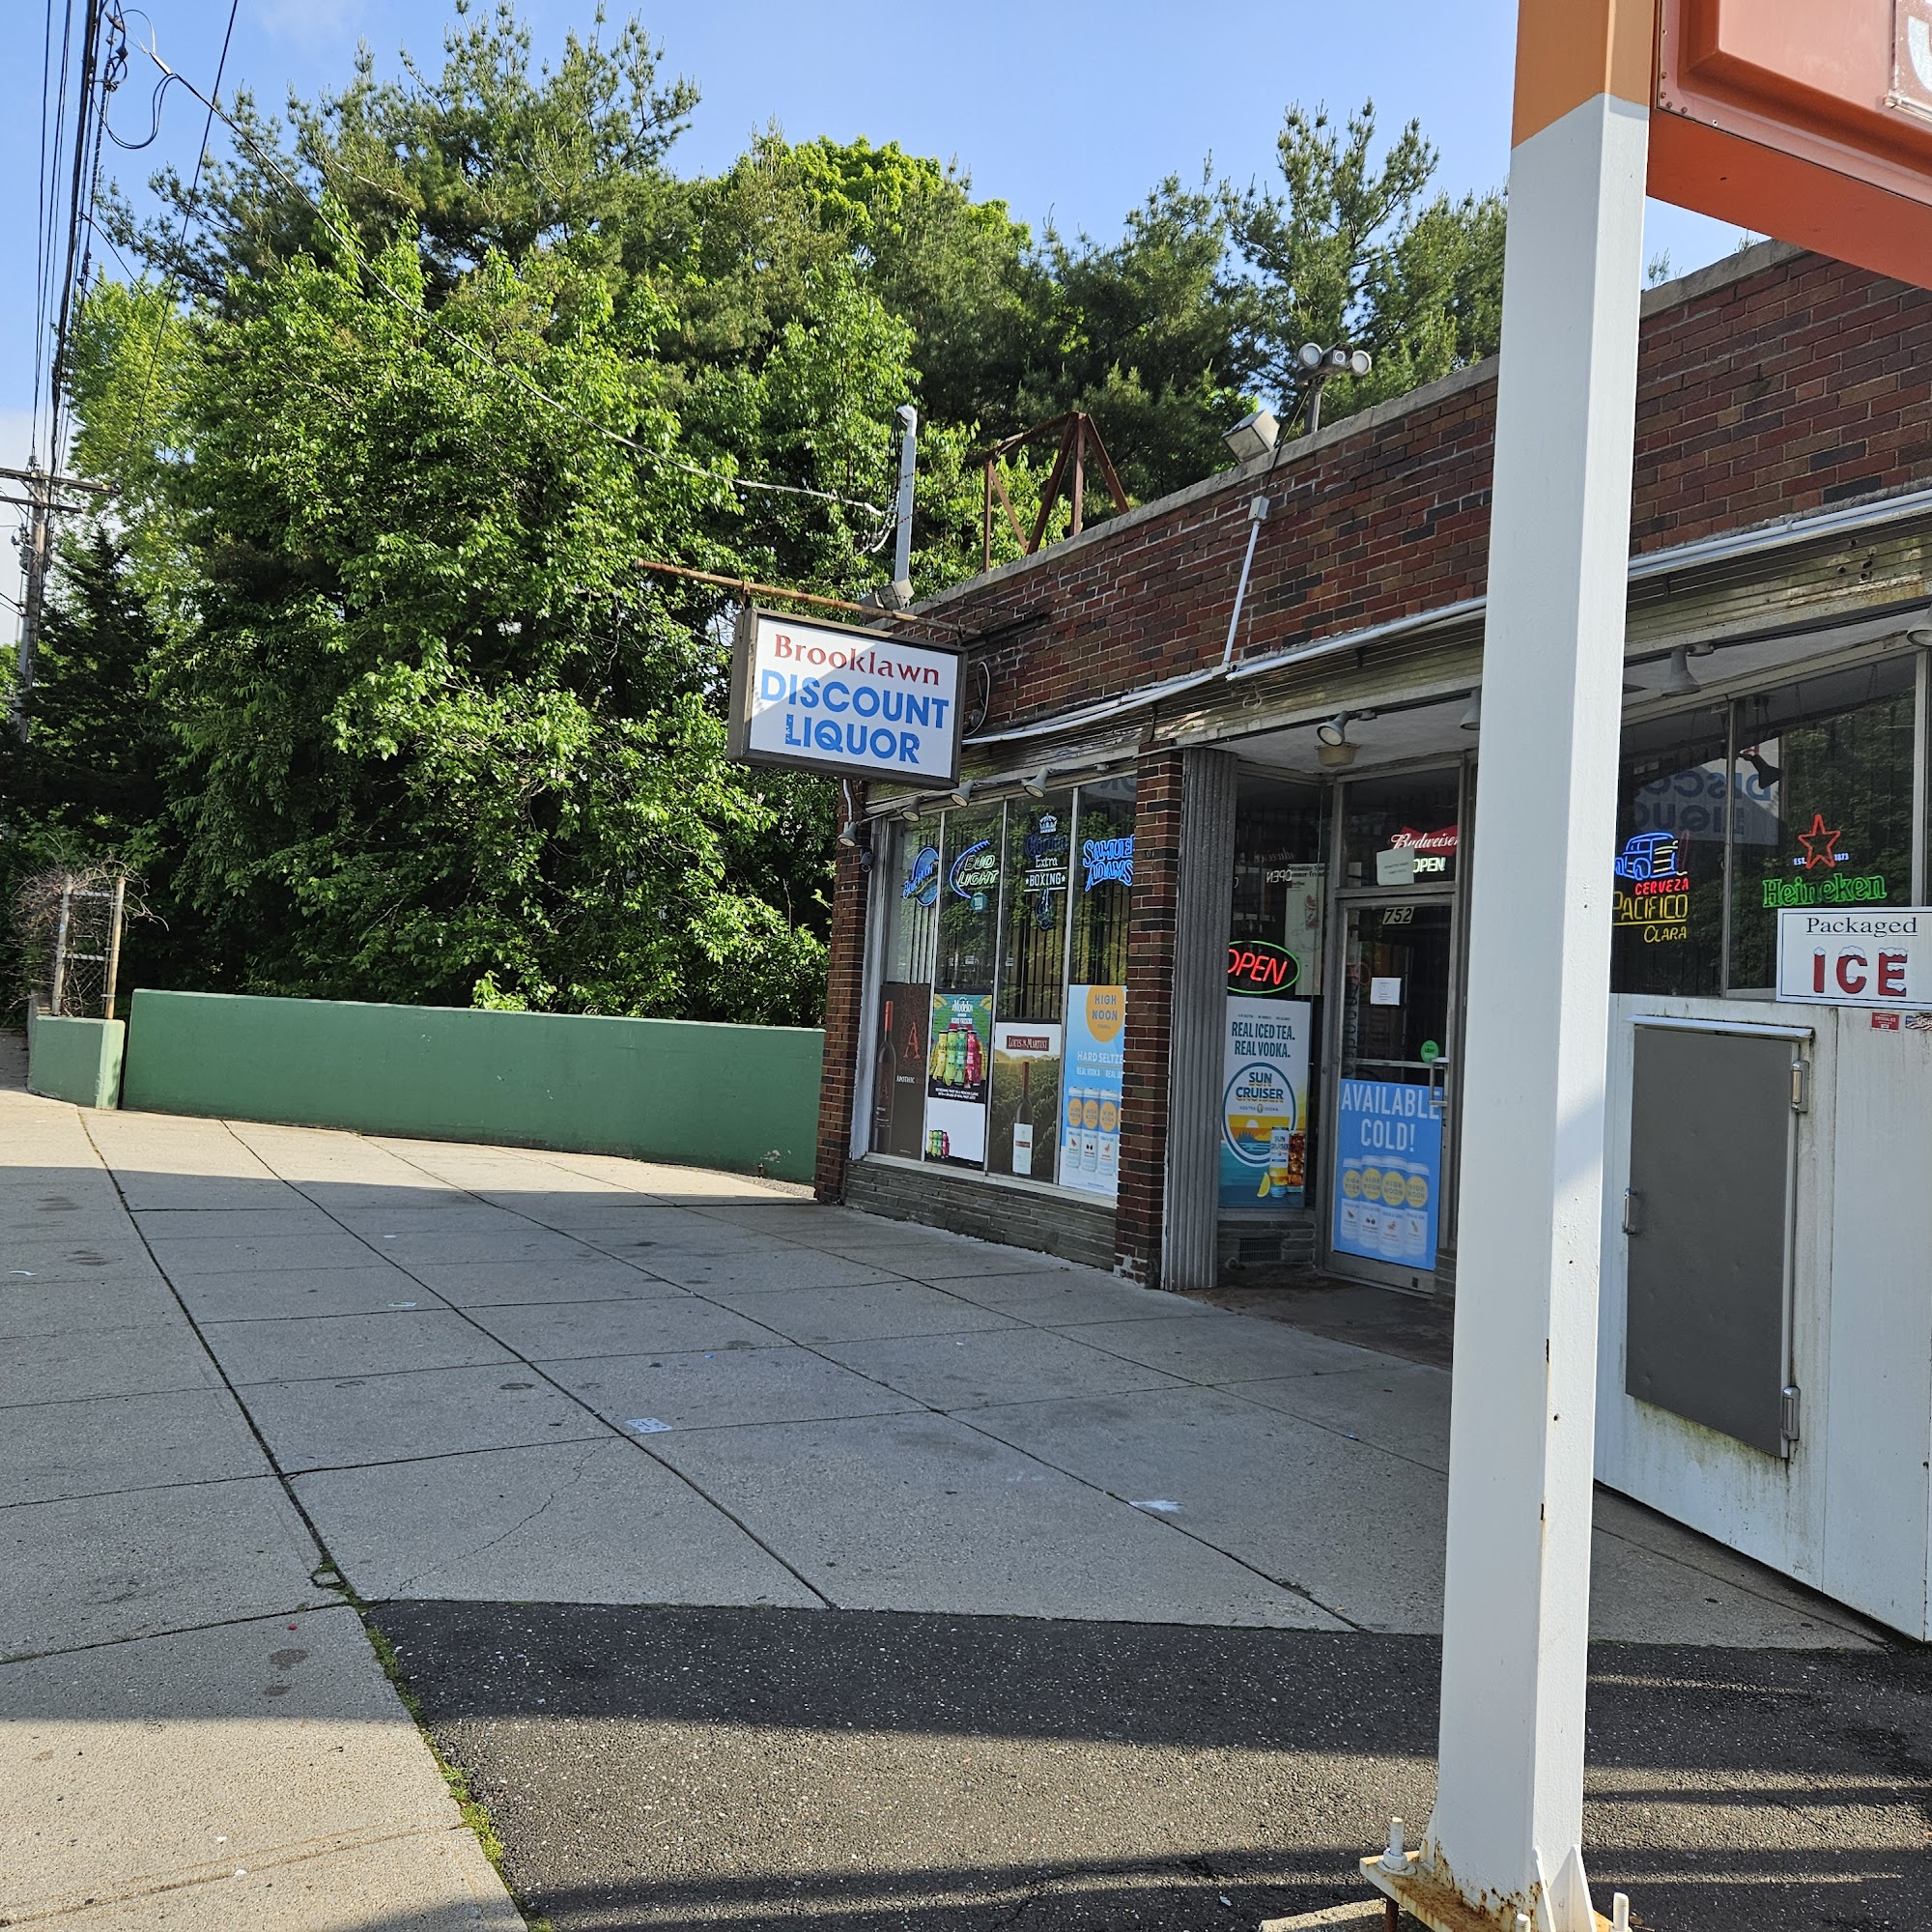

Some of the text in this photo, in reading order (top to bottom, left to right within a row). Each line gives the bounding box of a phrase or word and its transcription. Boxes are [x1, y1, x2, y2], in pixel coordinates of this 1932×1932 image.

[774, 634, 940, 686] Brooklawn
[760, 668, 950, 729] DISCOUNT
[784, 714, 921, 764] LIQUOR
[964, 855, 995, 871] BUD
[1036, 855, 1058, 867] Extra
[1833, 852, 1850, 862] 1873
[957, 870, 999, 887] LIGHT
[1029, 872, 1062, 886] BOXING
[1085, 860, 1134, 892] ADAMS
[1634, 877, 1690, 895] CERVEZA
[1762, 872, 1888, 908] Heineken
[1384, 908, 1412, 923] 752
[1643, 924, 1688, 944] CLARA
[1805, 917, 1918, 938] Packaged
[1813, 946, 1908, 997] ICE
[1094, 994, 1117, 1005] HIGH
[1092, 1009, 1118, 1021] NOON
[1232, 1022, 1295, 1040] REAL ICED TEA.
[1077, 1051, 1123, 1065] HARD SELTZE
[1235, 1040, 1291, 1058] REAL VODKA.
[1248, 1072, 1272, 1084] SUN
[1236, 1086, 1284, 1099] CRUISER
[1341, 1083, 1440, 1121] AVAILABLE
[1360, 1118, 1416, 1152] COLD!
